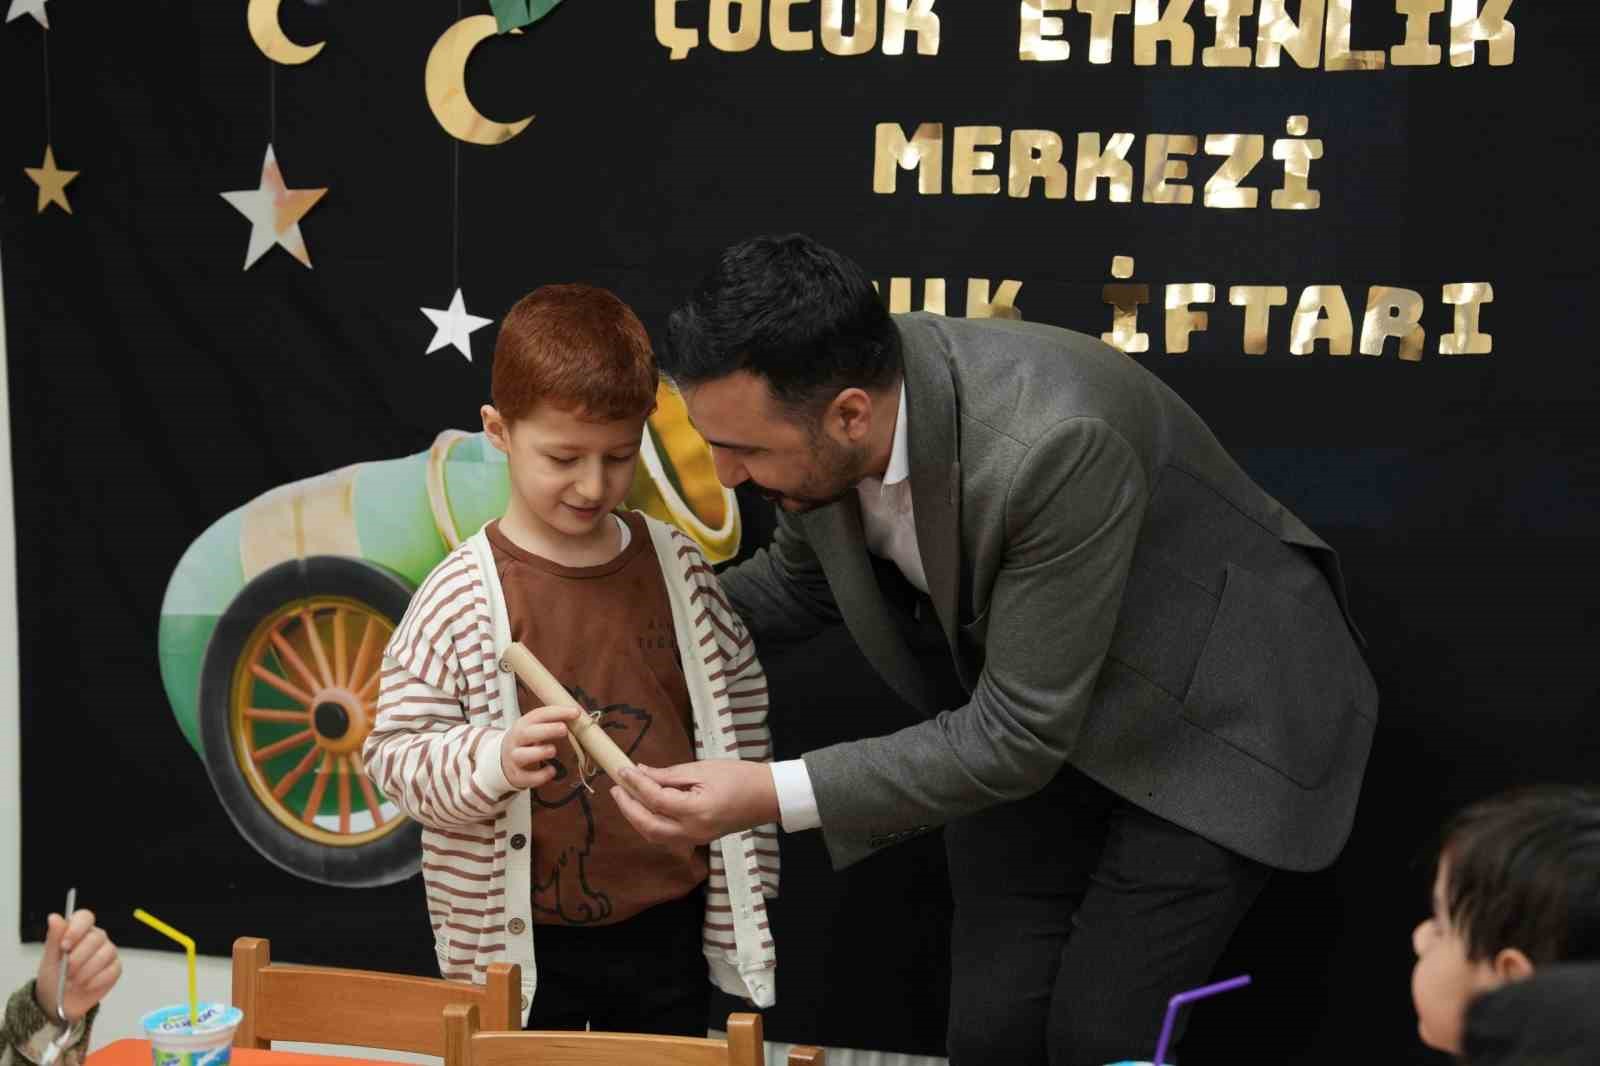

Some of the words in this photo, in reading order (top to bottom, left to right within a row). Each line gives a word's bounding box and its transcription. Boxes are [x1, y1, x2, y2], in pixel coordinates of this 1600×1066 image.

[655, 0, 940, 60] ÇOCUK
[873, 115, 1323, 210] MERKEZİ
[1101, 256, 1494, 361] İFTARI
